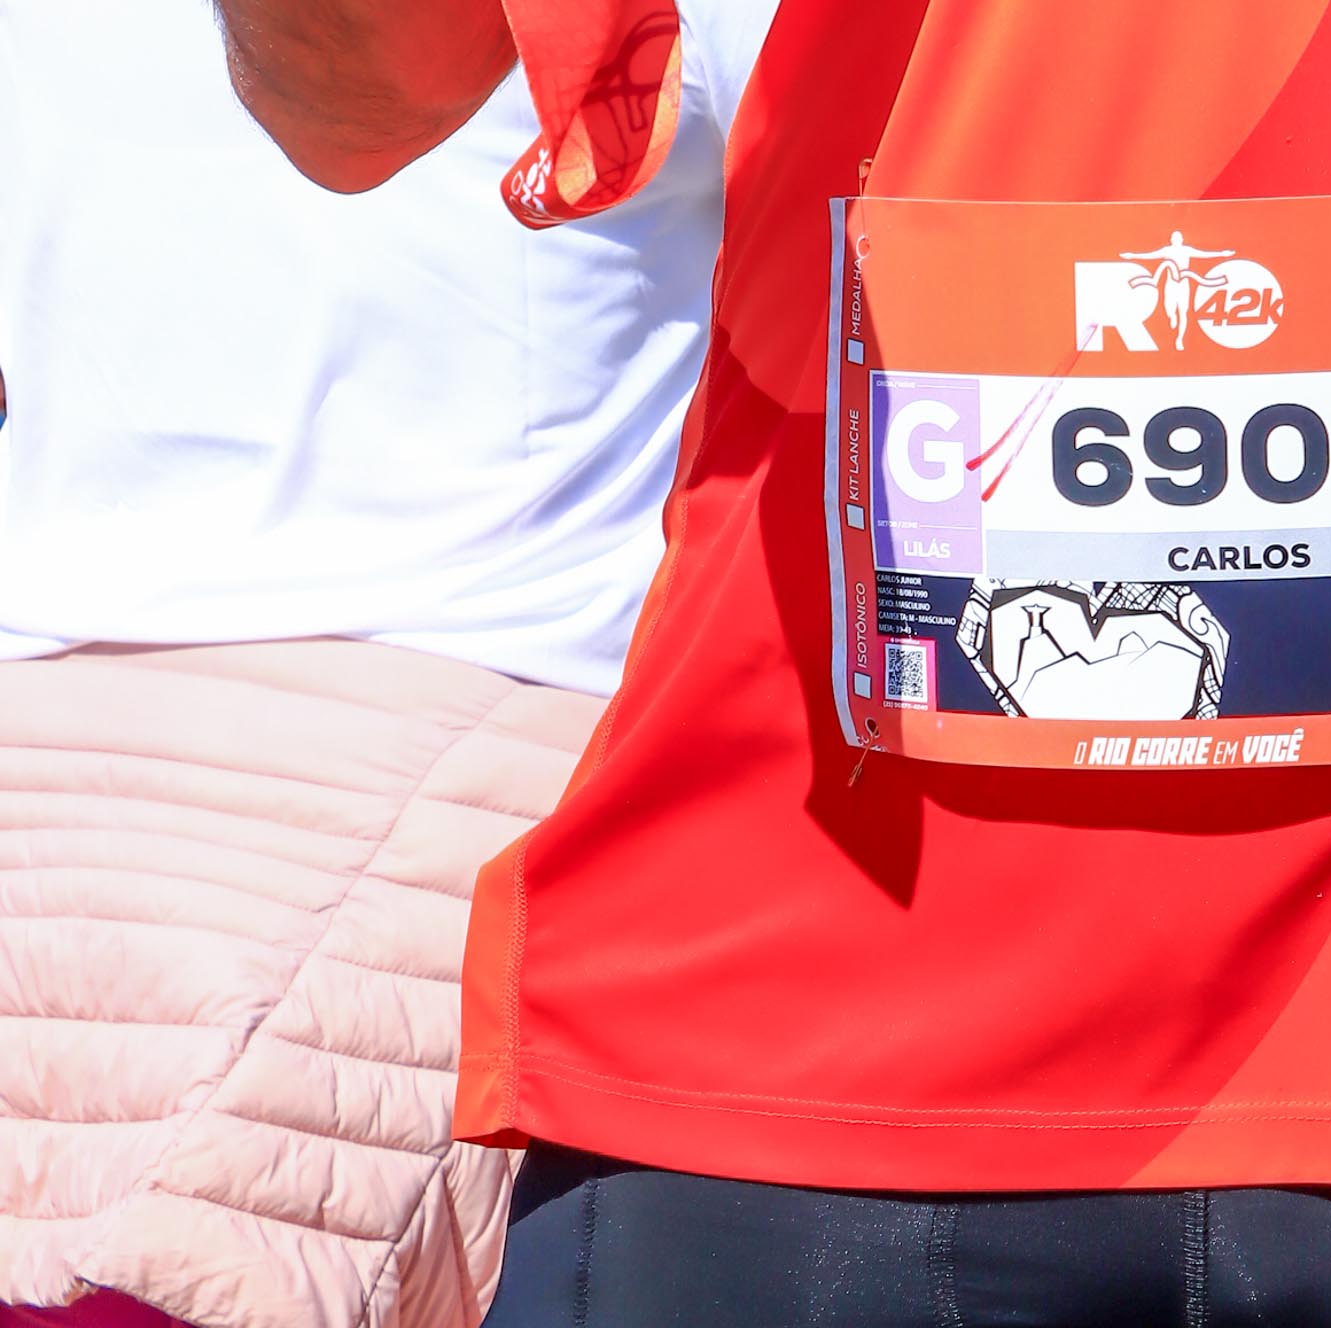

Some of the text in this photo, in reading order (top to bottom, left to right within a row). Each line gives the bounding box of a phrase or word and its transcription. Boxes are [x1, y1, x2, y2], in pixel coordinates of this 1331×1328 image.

[851, 256, 864, 336] MEDALHA
[848, 408, 860, 501] KIT LANCHE
[886, 399, 965, 503] G
[903, 538, 951, 559] LILÁS
[1168, 544, 1312, 572] CARLOS
[876, 573, 922, 586] CARLOS JUNIOR
[855, 582, 867, 668] ISOTÔNICO
[918, 615, 957, 626] MASCULINO
[1073, 728, 1305, 766] O RIO CORRE EM VOCÊ
